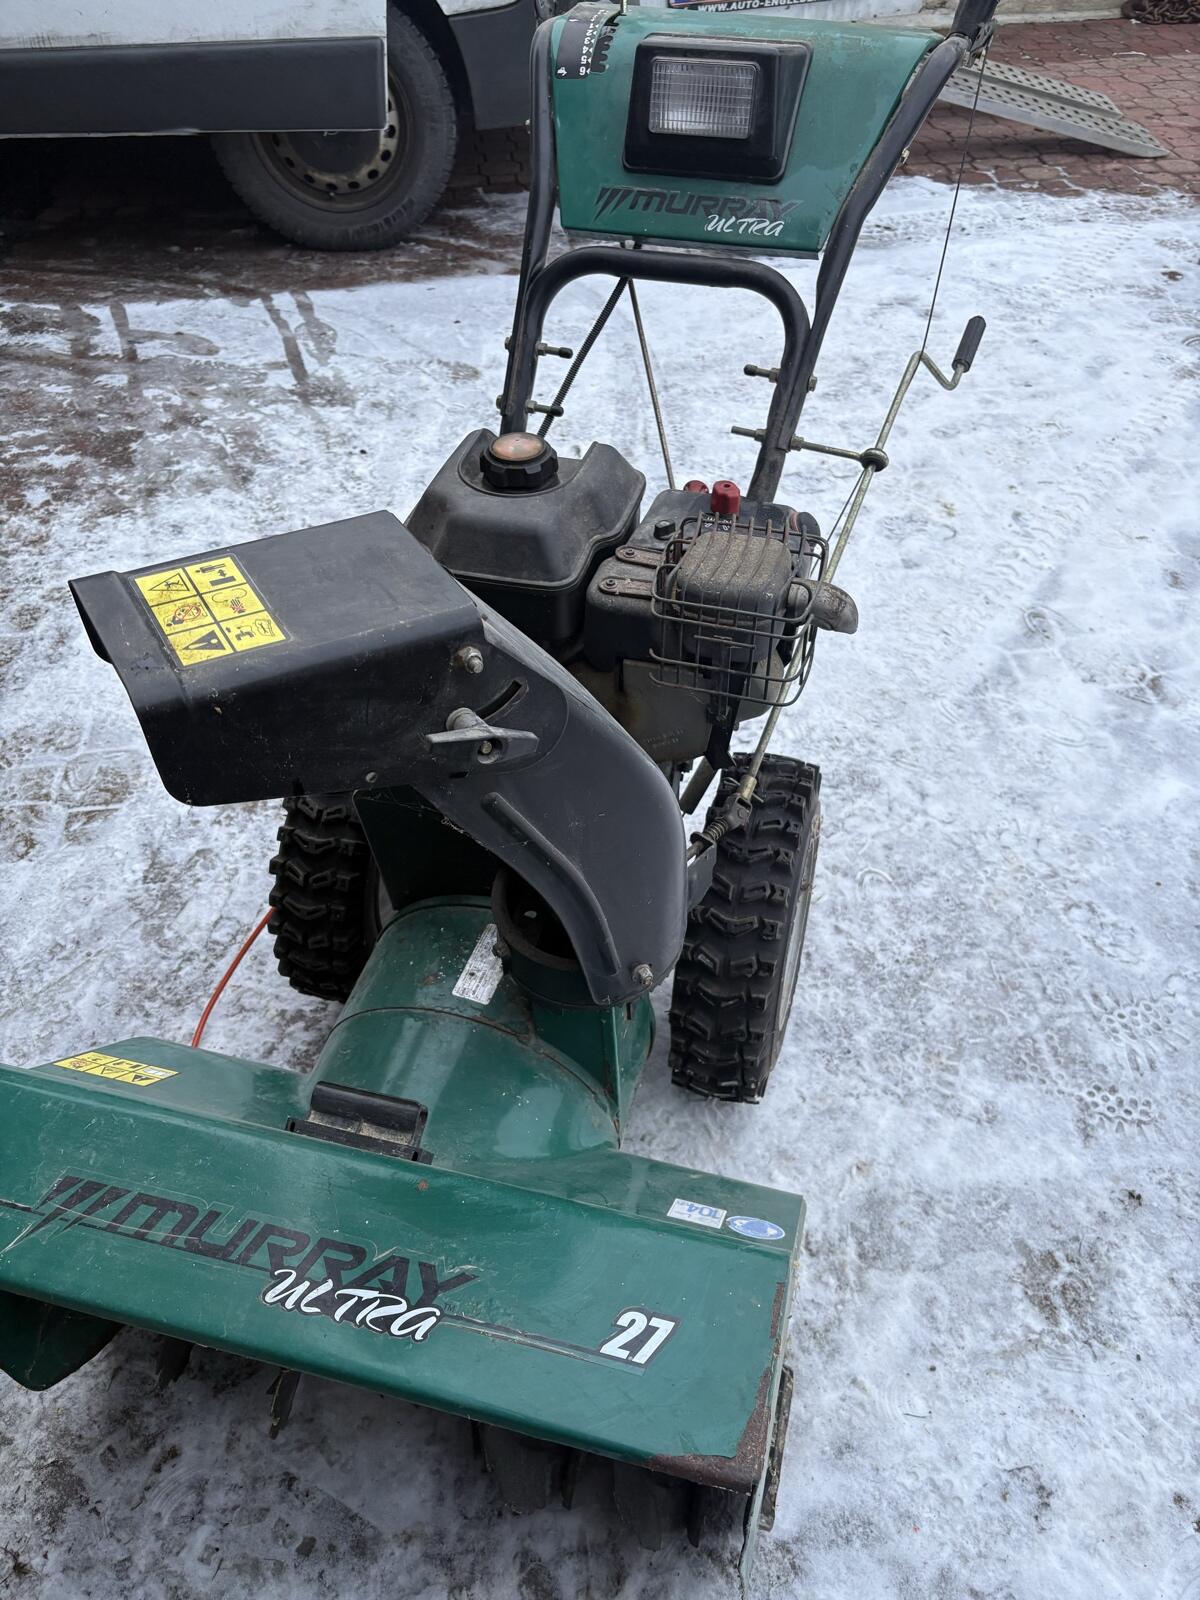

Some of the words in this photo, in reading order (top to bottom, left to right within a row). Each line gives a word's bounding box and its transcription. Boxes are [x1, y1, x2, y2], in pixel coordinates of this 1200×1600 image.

[581, 55, 588, 64] 5
[582, 46, 589, 54] 4
[579, 66, 586, 75] 6
[628, 189, 801, 221] MURRAY
[705, 214, 785, 237] ULTRA
[101, 1191, 479, 1306] MURRAY
[264, 1269, 441, 1341] ULTRA
[600, 1311, 675, 1364] 27
